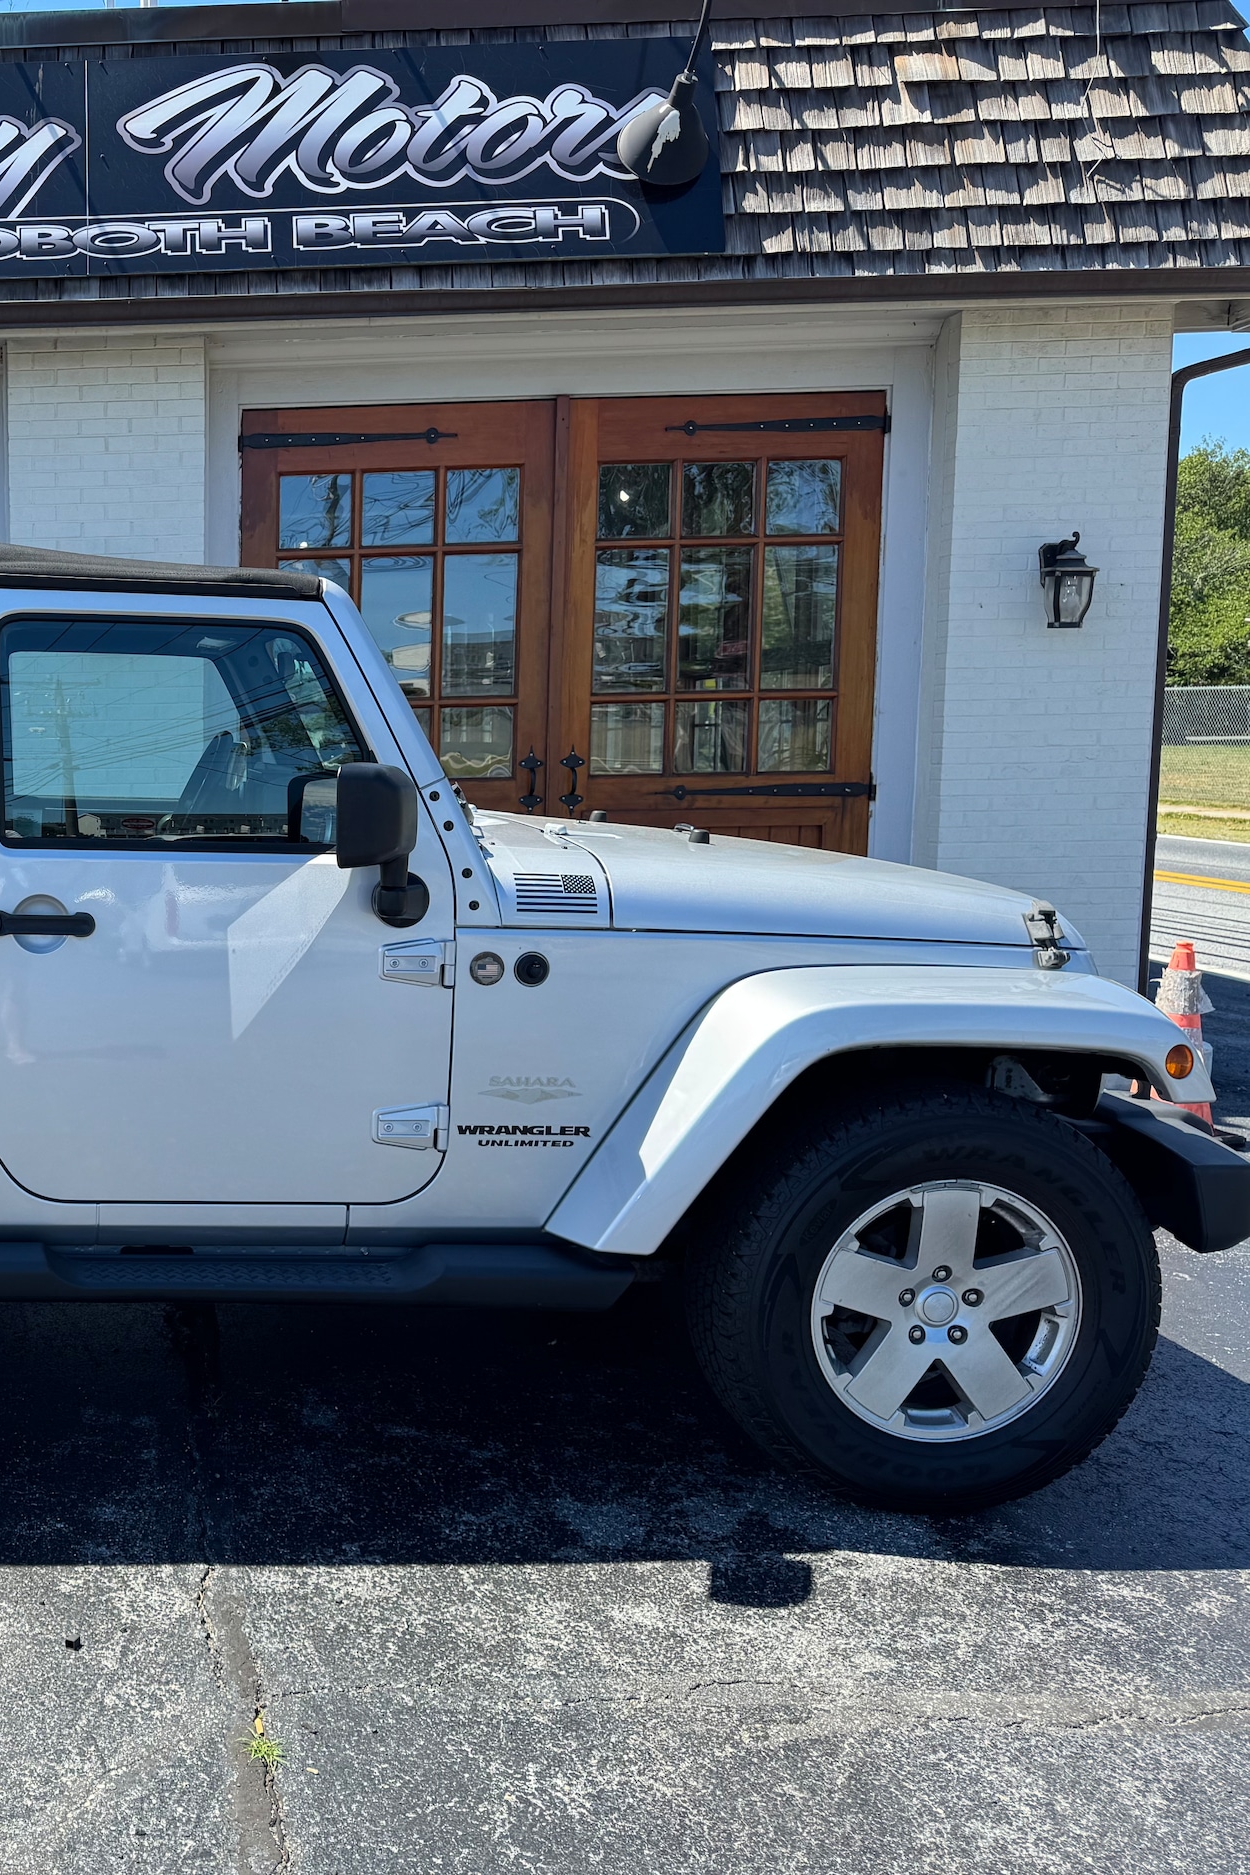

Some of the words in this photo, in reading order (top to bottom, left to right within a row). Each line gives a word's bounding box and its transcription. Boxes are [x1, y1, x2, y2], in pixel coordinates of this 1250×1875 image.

[293, 205, 610, 250] BEACH
[488, 1076, 576, 1088] SAHARA
[457, 1125, 591, 1137] WRANGLER
[802, 1204, 834, 1241] Kevlar
[922, 1145, 1126, 1296] WRANGLER
